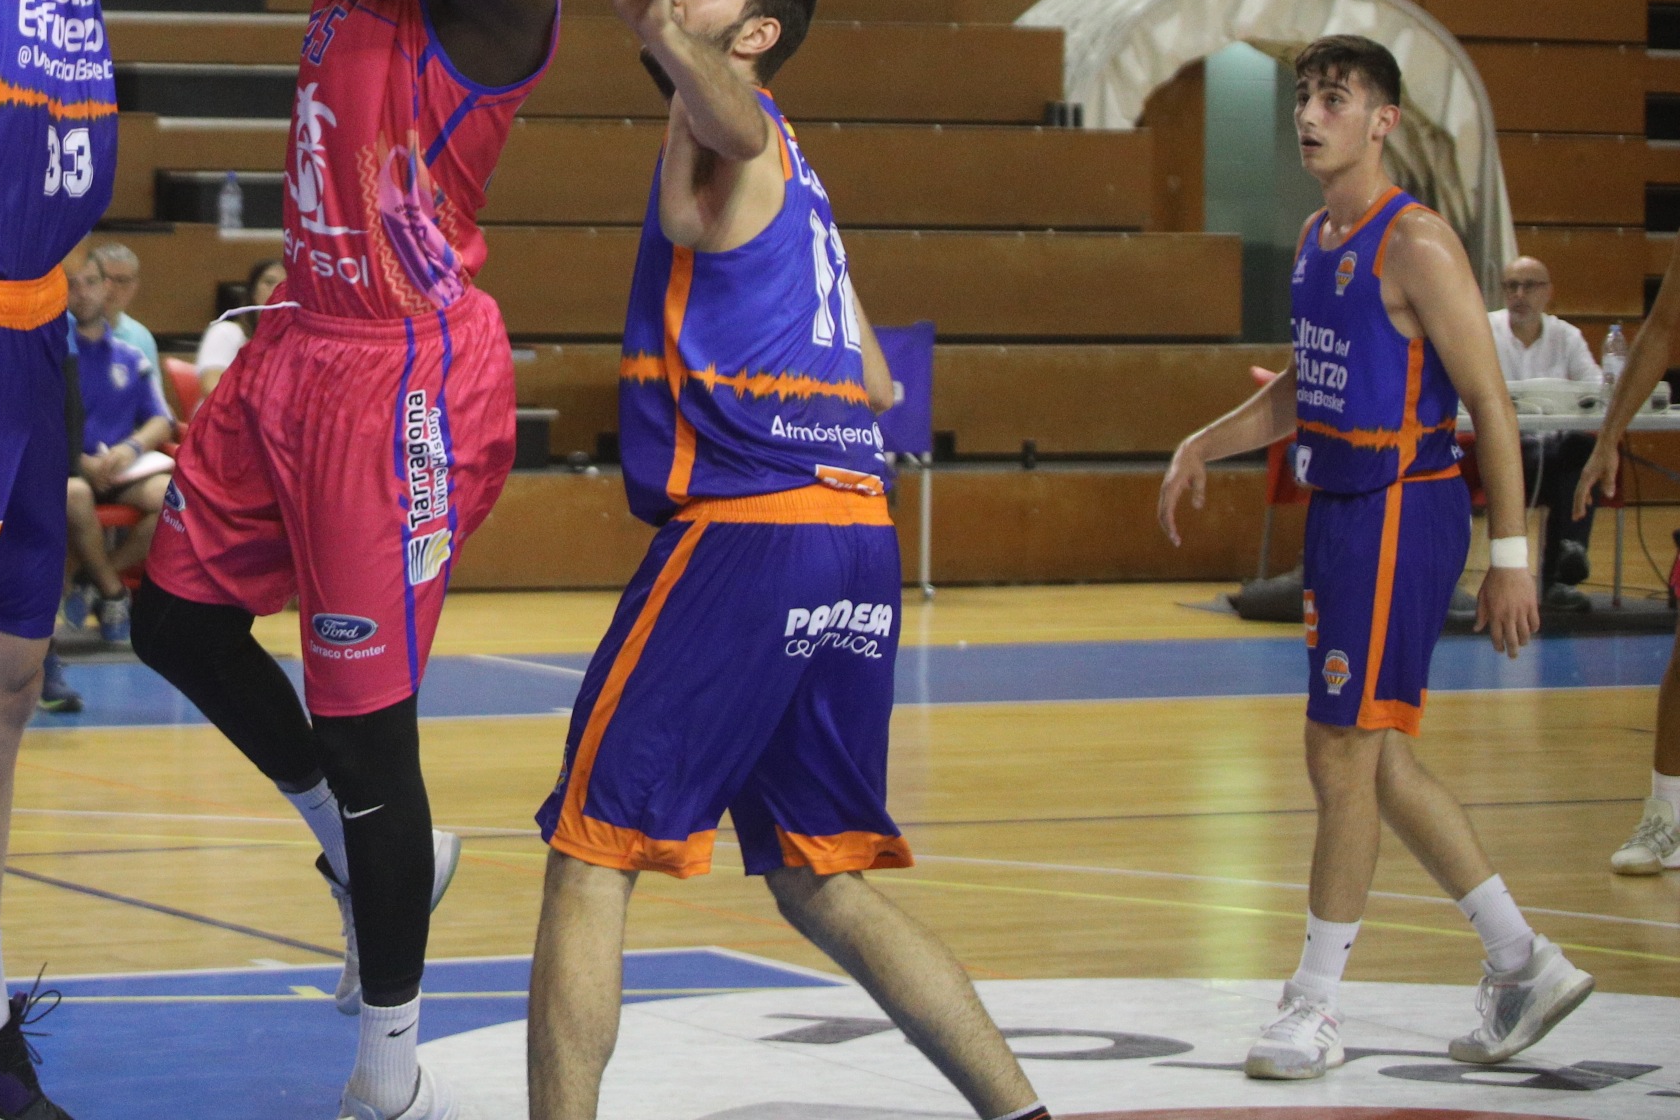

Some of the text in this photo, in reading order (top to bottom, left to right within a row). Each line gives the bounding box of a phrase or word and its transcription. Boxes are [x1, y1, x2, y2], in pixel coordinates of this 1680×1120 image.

[44, 125, 94, 197] 33
[771, 415, 873, 452] Atmósfera
[406, 390, 431, 532] Tarragona
[321, 620, 359, 638] Ford
[784, 599, 893, 637] PAMESA
[344, 644, 386, 659] Center
